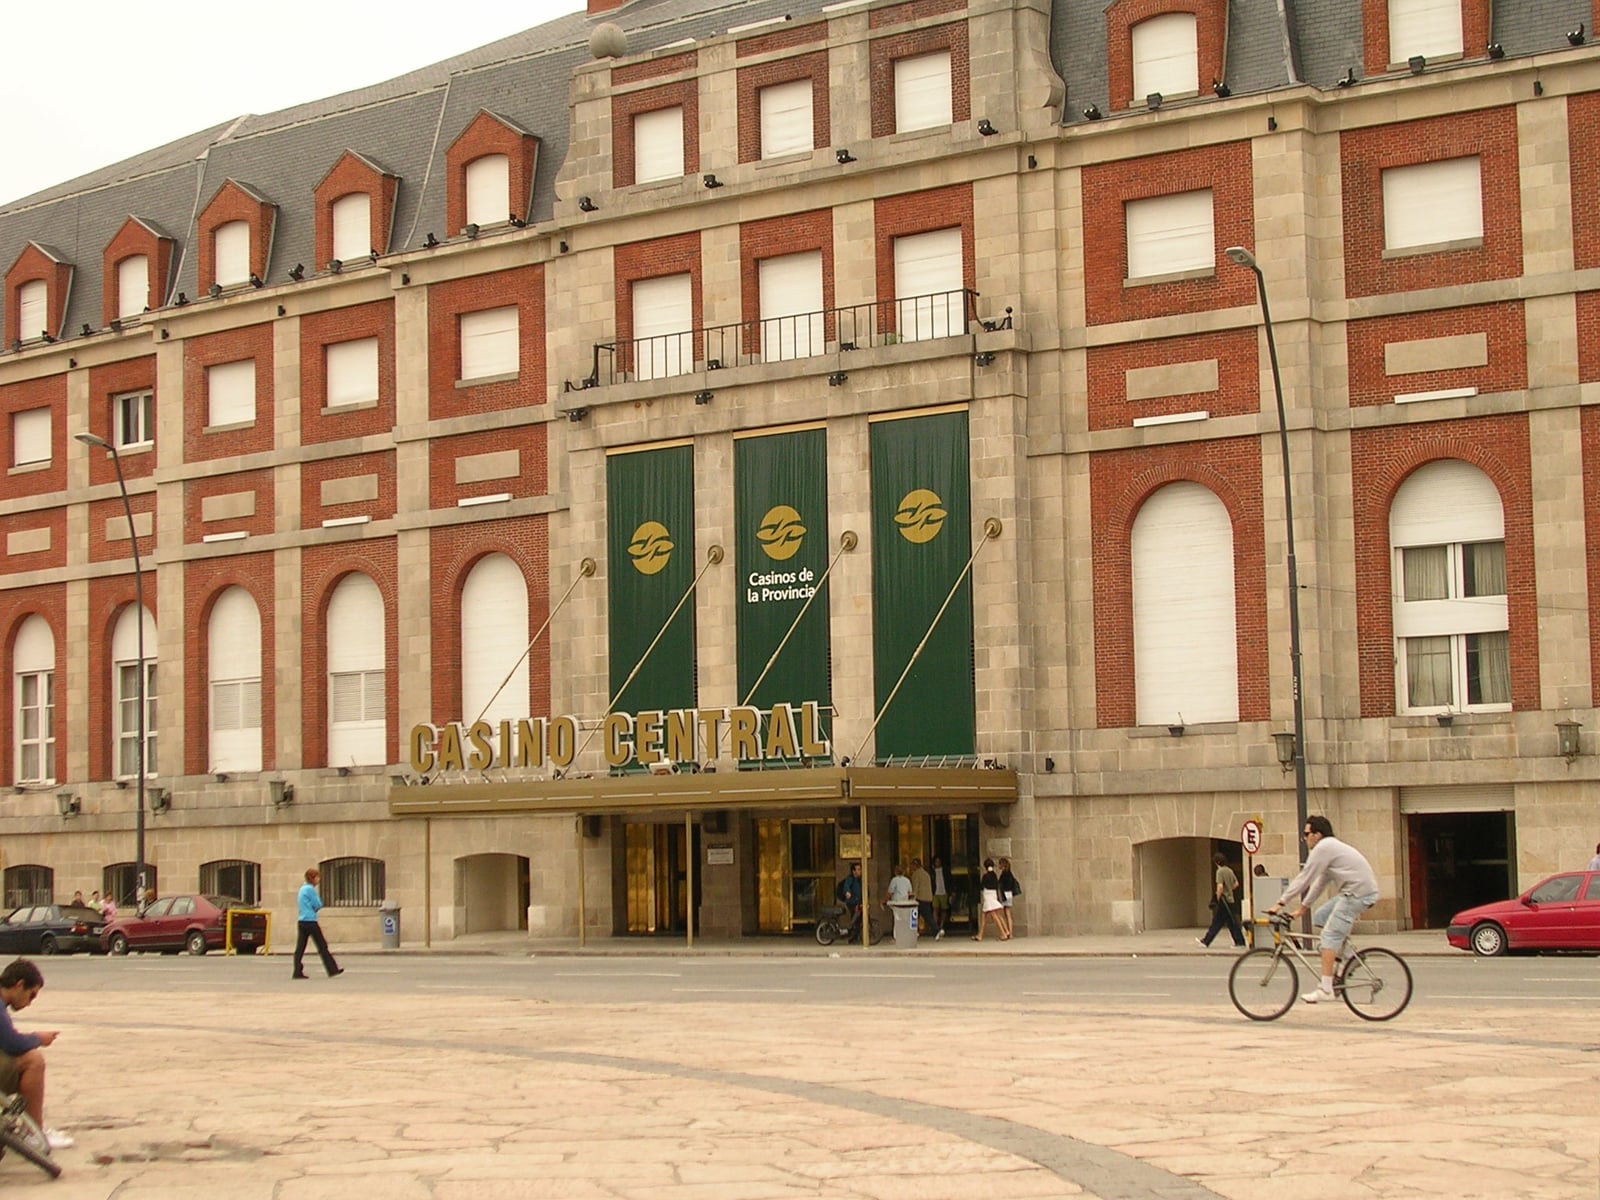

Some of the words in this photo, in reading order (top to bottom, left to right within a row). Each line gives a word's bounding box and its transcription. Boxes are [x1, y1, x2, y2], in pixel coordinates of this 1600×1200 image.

[749, 571, 796, 586] Casinos
[798, 567, 814, 582] de
[747, 588, 759, 603] la
[762, 584, 815, 601] Provincia
[410, 715, 579, 773] CASINO
[603, 701, 829, 767] CENTRAL
[1248, 830, 1256, 843] E
